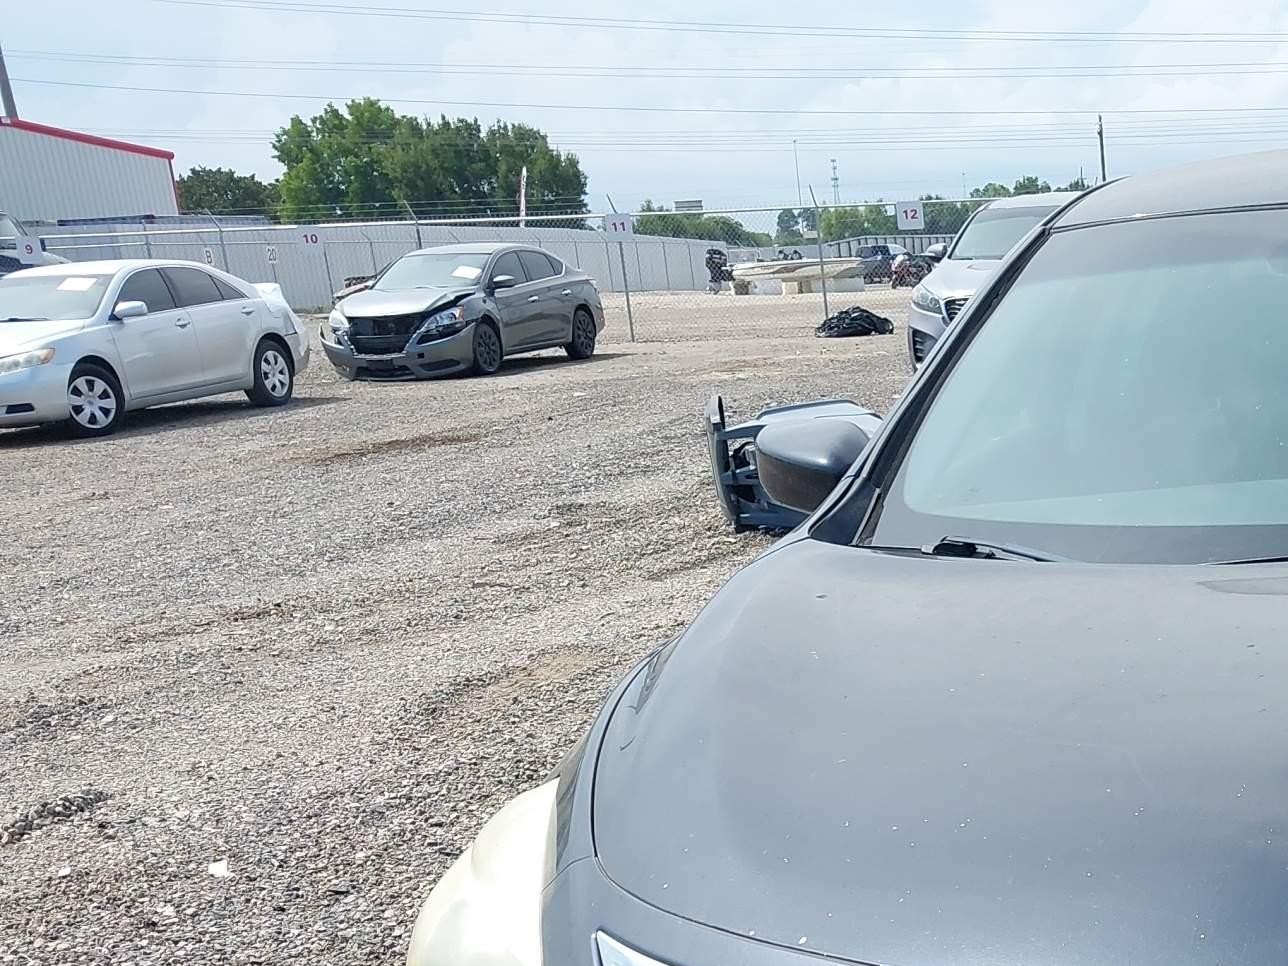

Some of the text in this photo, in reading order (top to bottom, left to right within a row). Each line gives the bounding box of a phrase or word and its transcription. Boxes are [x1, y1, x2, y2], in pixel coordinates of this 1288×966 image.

[902, 208, 919, 220] 12
[611, 221, 626, 233] 11
[302, 233, 319, 244] 10
[24, 244, 33, 255] 9
